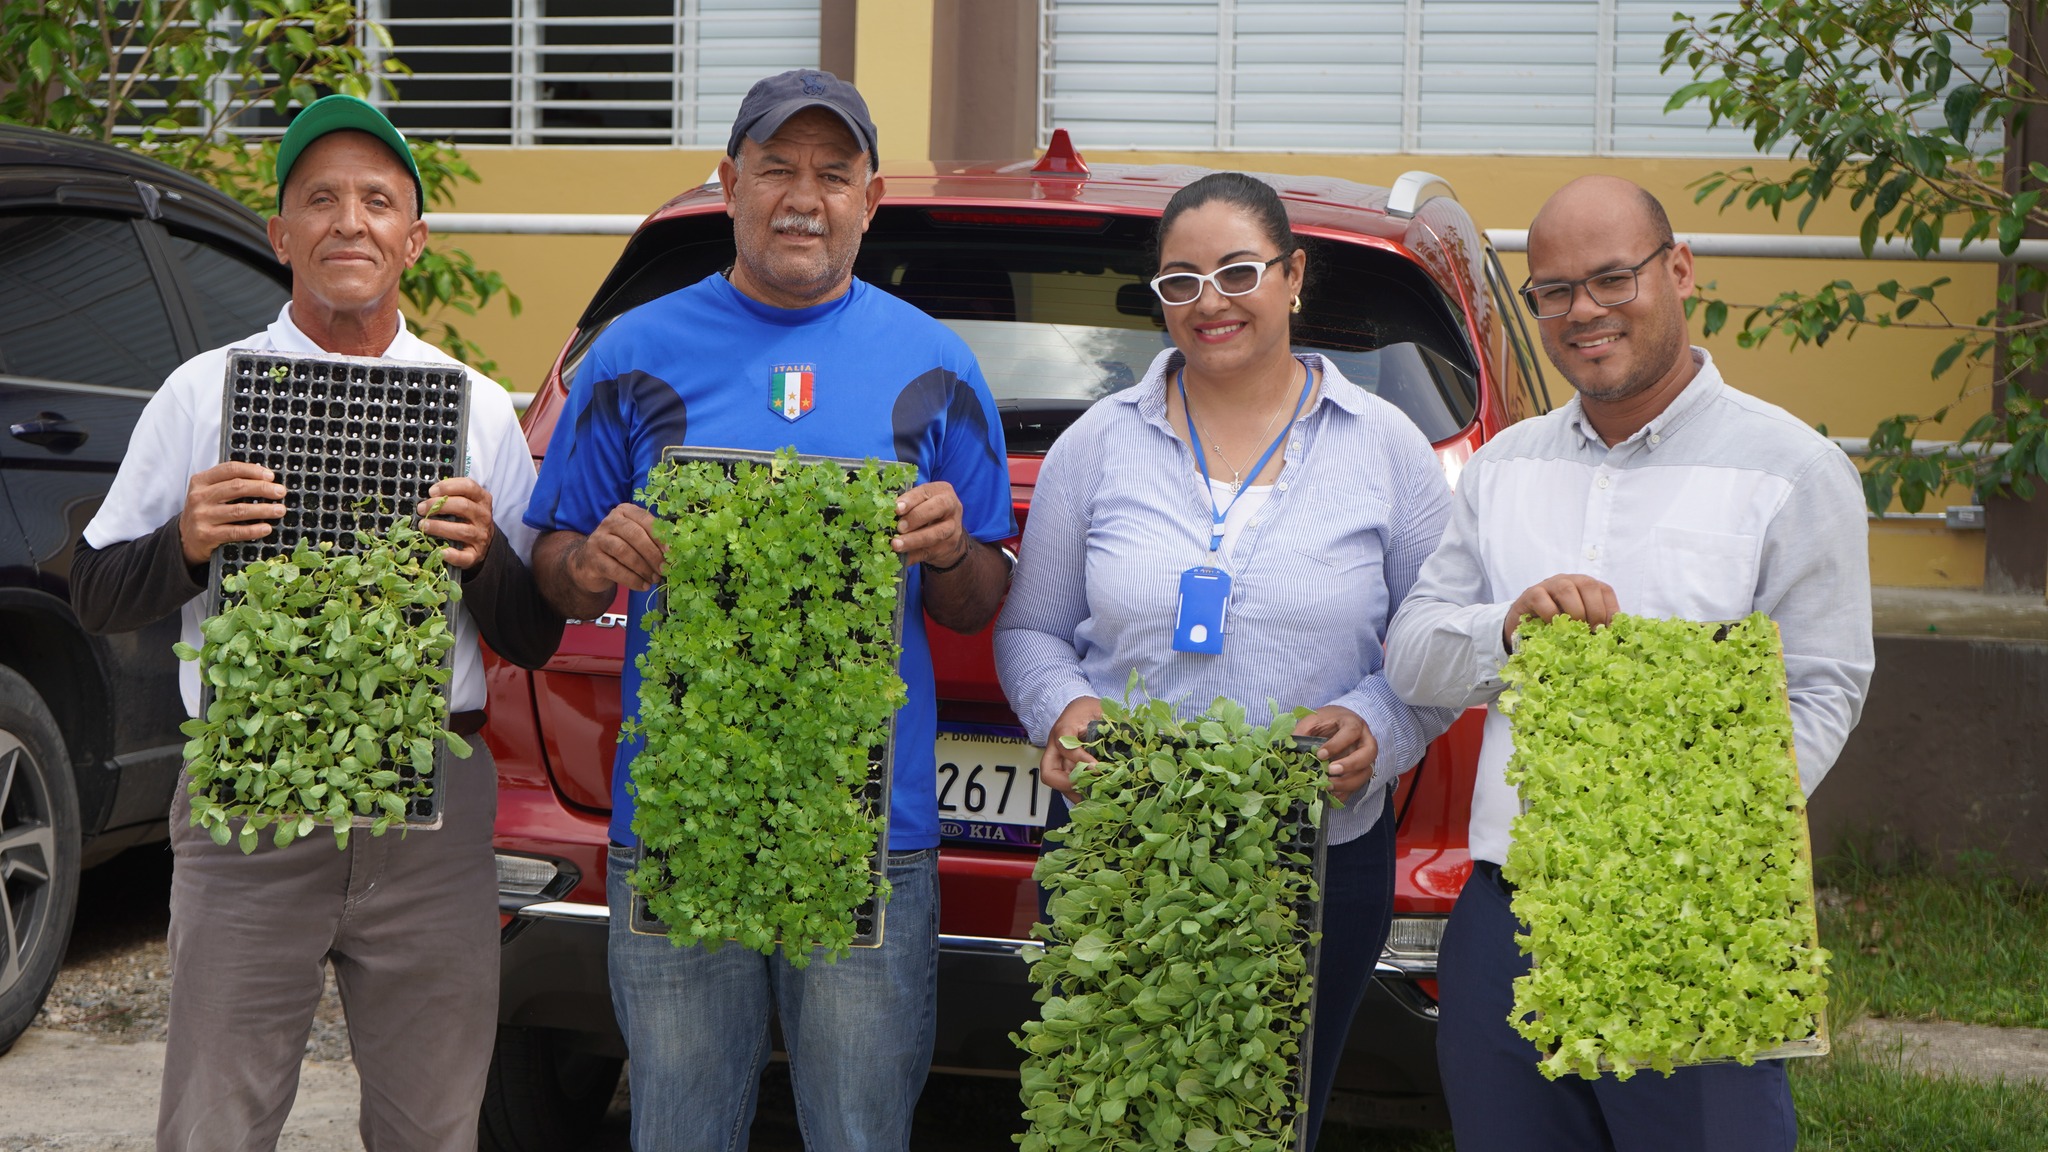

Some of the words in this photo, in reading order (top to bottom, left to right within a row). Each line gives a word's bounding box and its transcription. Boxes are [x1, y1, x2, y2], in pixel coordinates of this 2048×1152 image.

[774, 365, 812, 373] ITALIA
[939, 763, 1039, 817] 2671
[941, 825, 958, 834] KIA
[969, 824, 1005, 839] KIA
